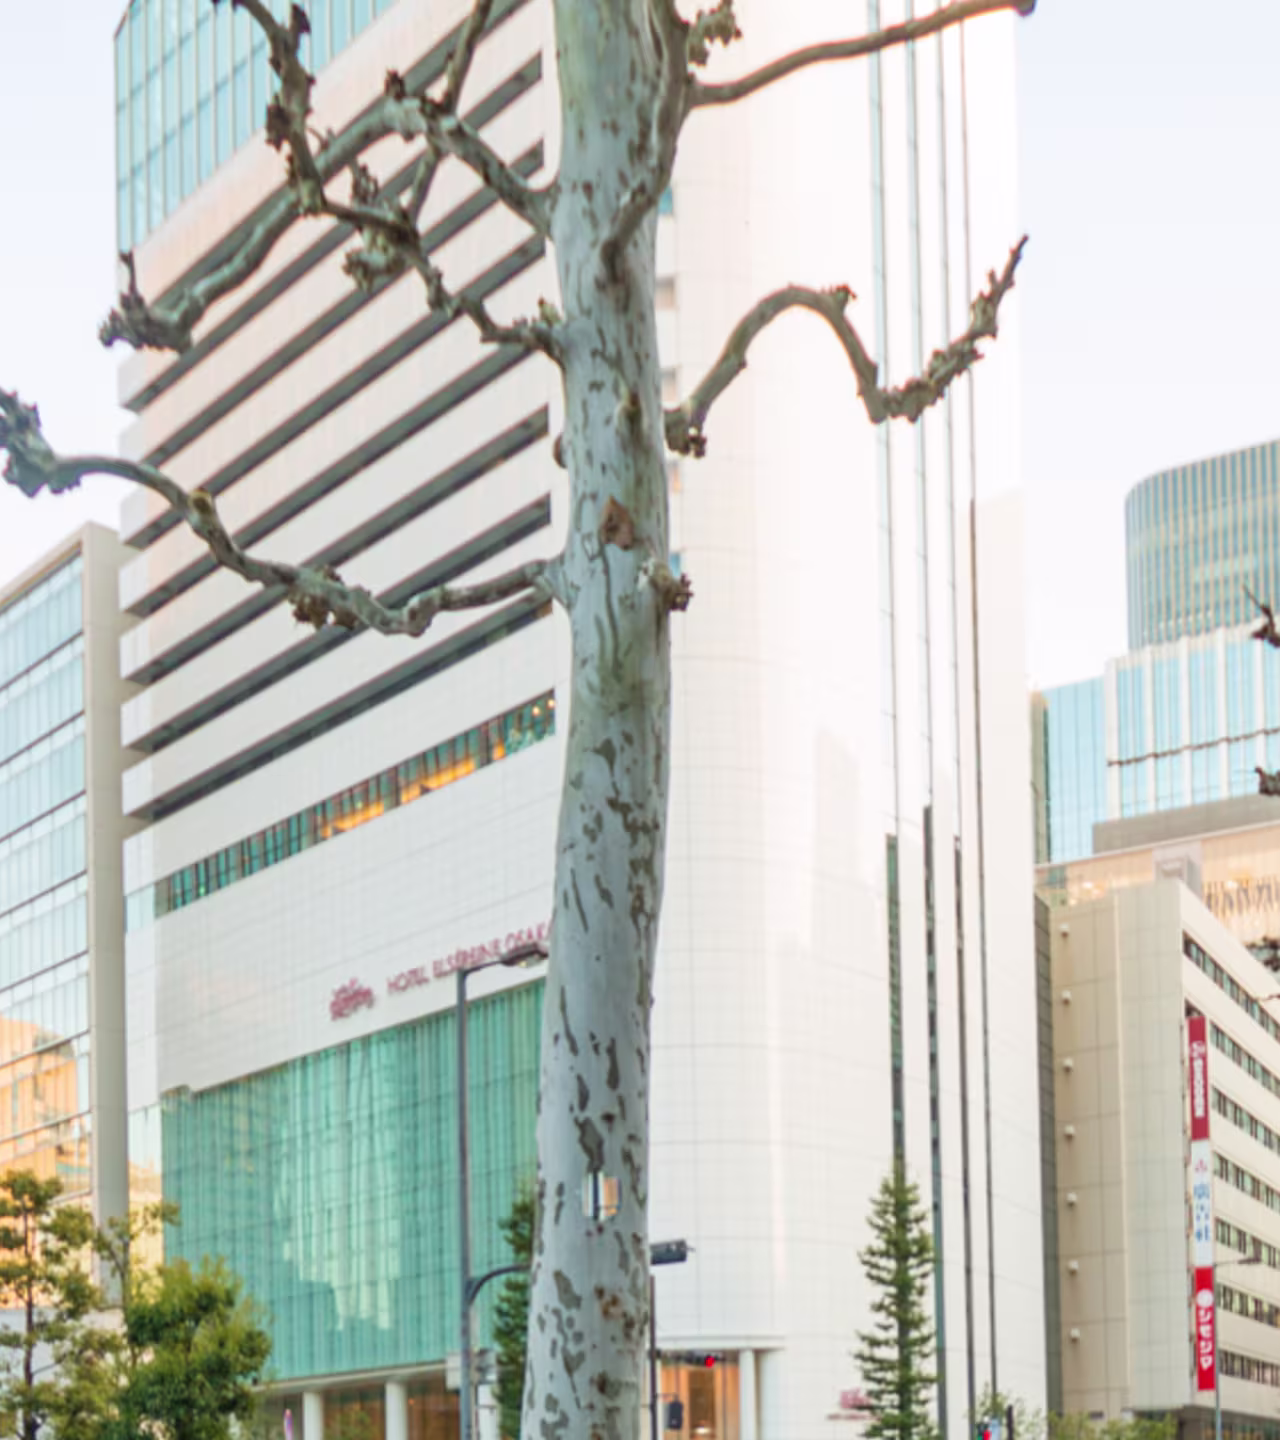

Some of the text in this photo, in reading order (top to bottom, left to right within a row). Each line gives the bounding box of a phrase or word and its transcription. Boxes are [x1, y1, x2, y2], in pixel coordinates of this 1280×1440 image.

[387, 966, 431, 993] HOTEL
[1199, 1308, 1214, 1371] シモジマ
